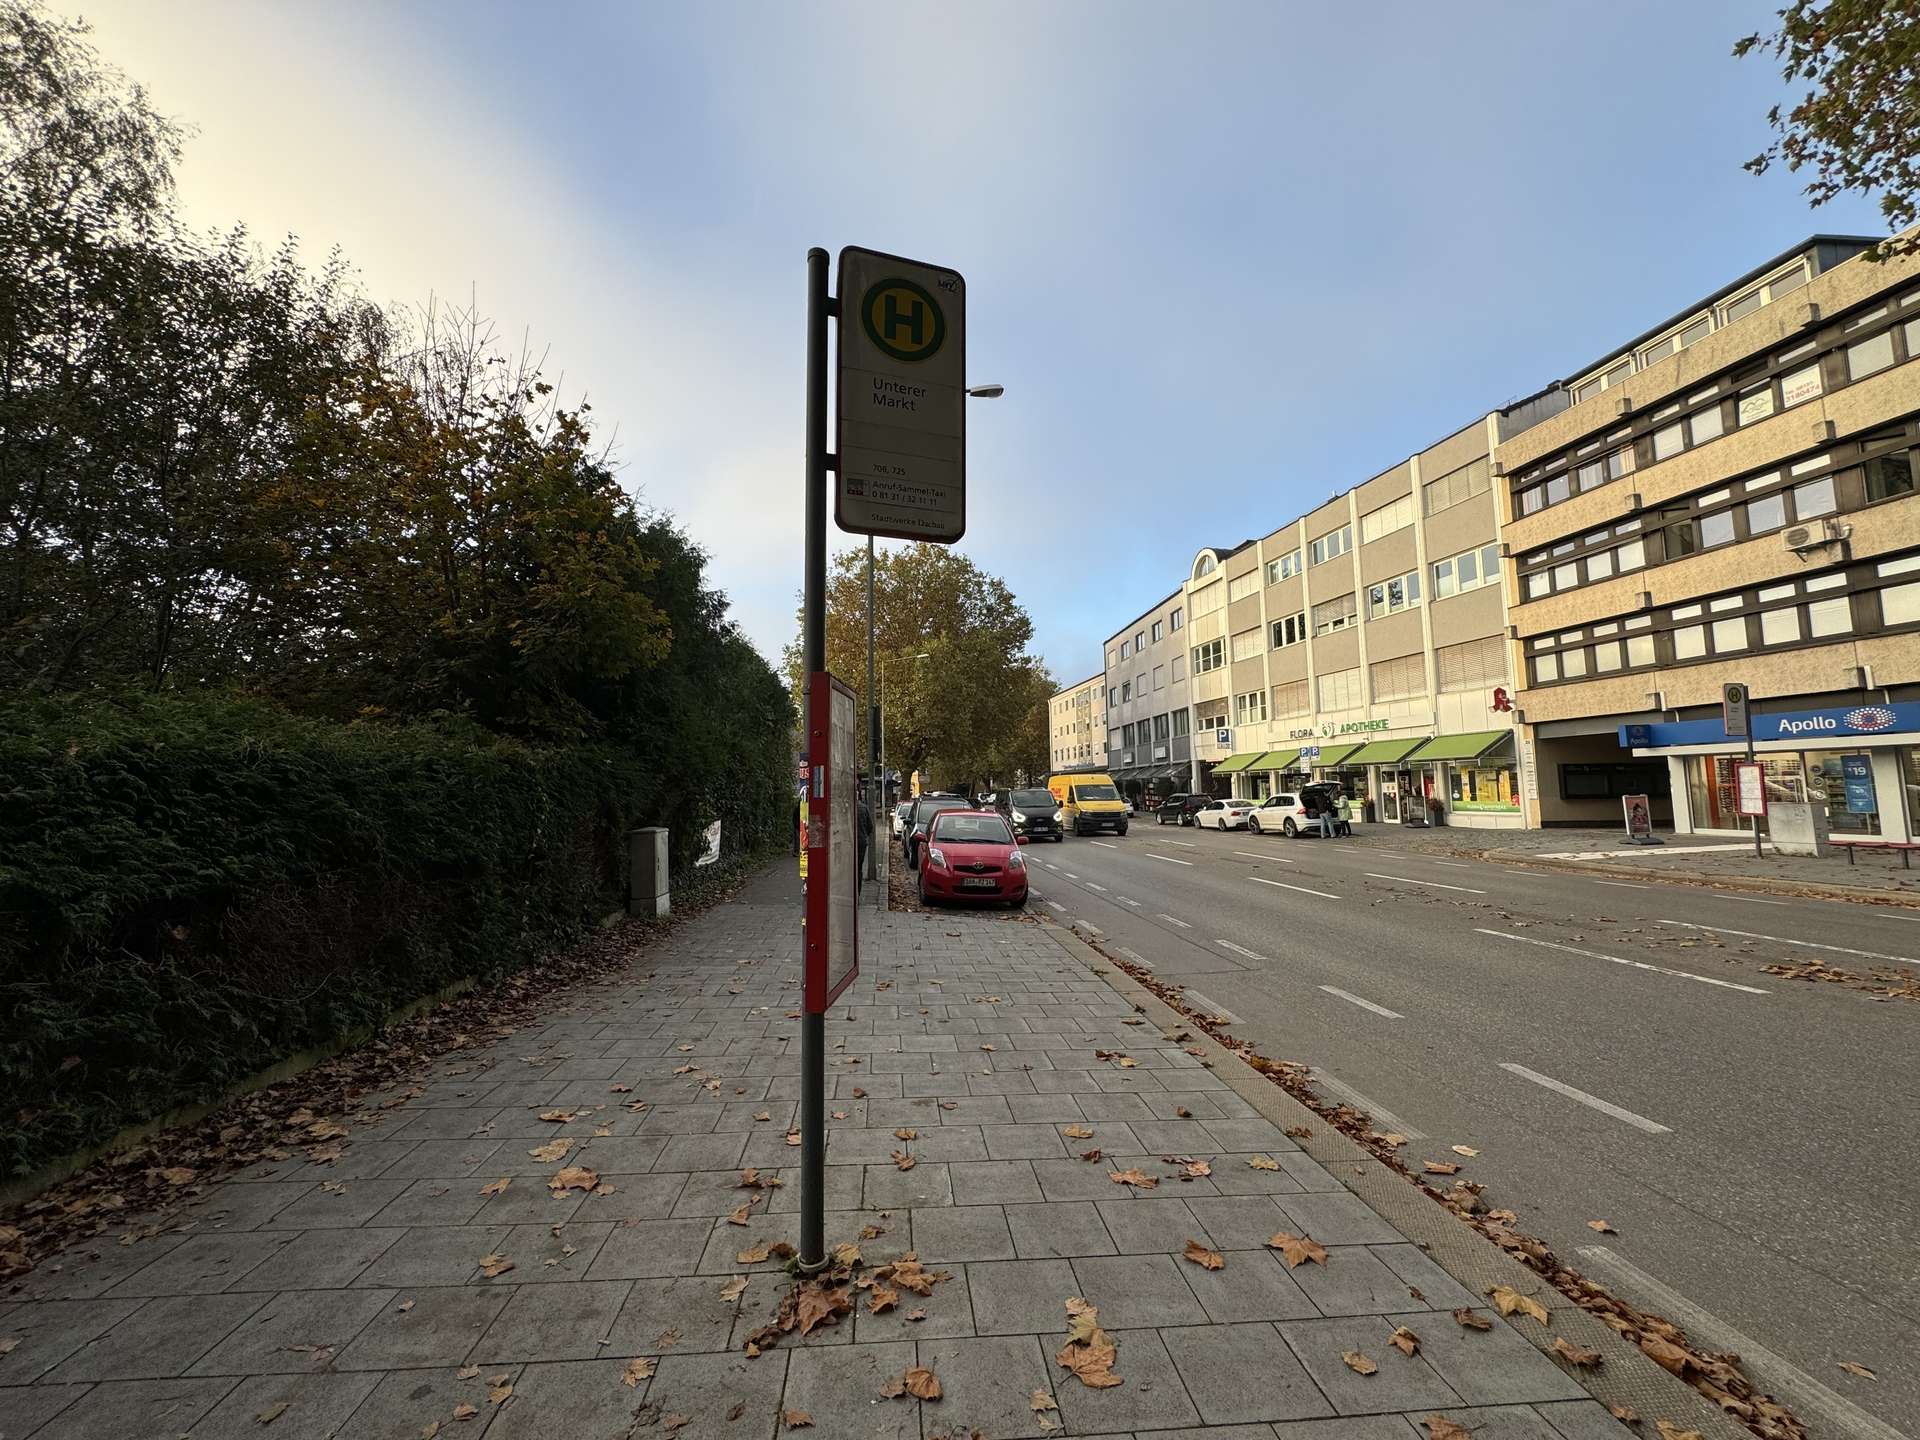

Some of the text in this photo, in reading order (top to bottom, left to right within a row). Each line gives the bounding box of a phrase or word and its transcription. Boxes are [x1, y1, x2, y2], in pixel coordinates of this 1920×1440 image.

[884, 294, 924, 345] H
[872, 376, 927, 398] Unterer
[872, 392, 917, 411] Markt
[872, 481, 946, 497] Anruf-Sammel-Taxi
[871, 513, 945, 529] Stadtwerke Dachau
[1289, 718, 1389, 739] FLORA APOTHEKE
[1778, 717, 1836, 734] Apollo
[1852, 766, 1866, 776] 19
